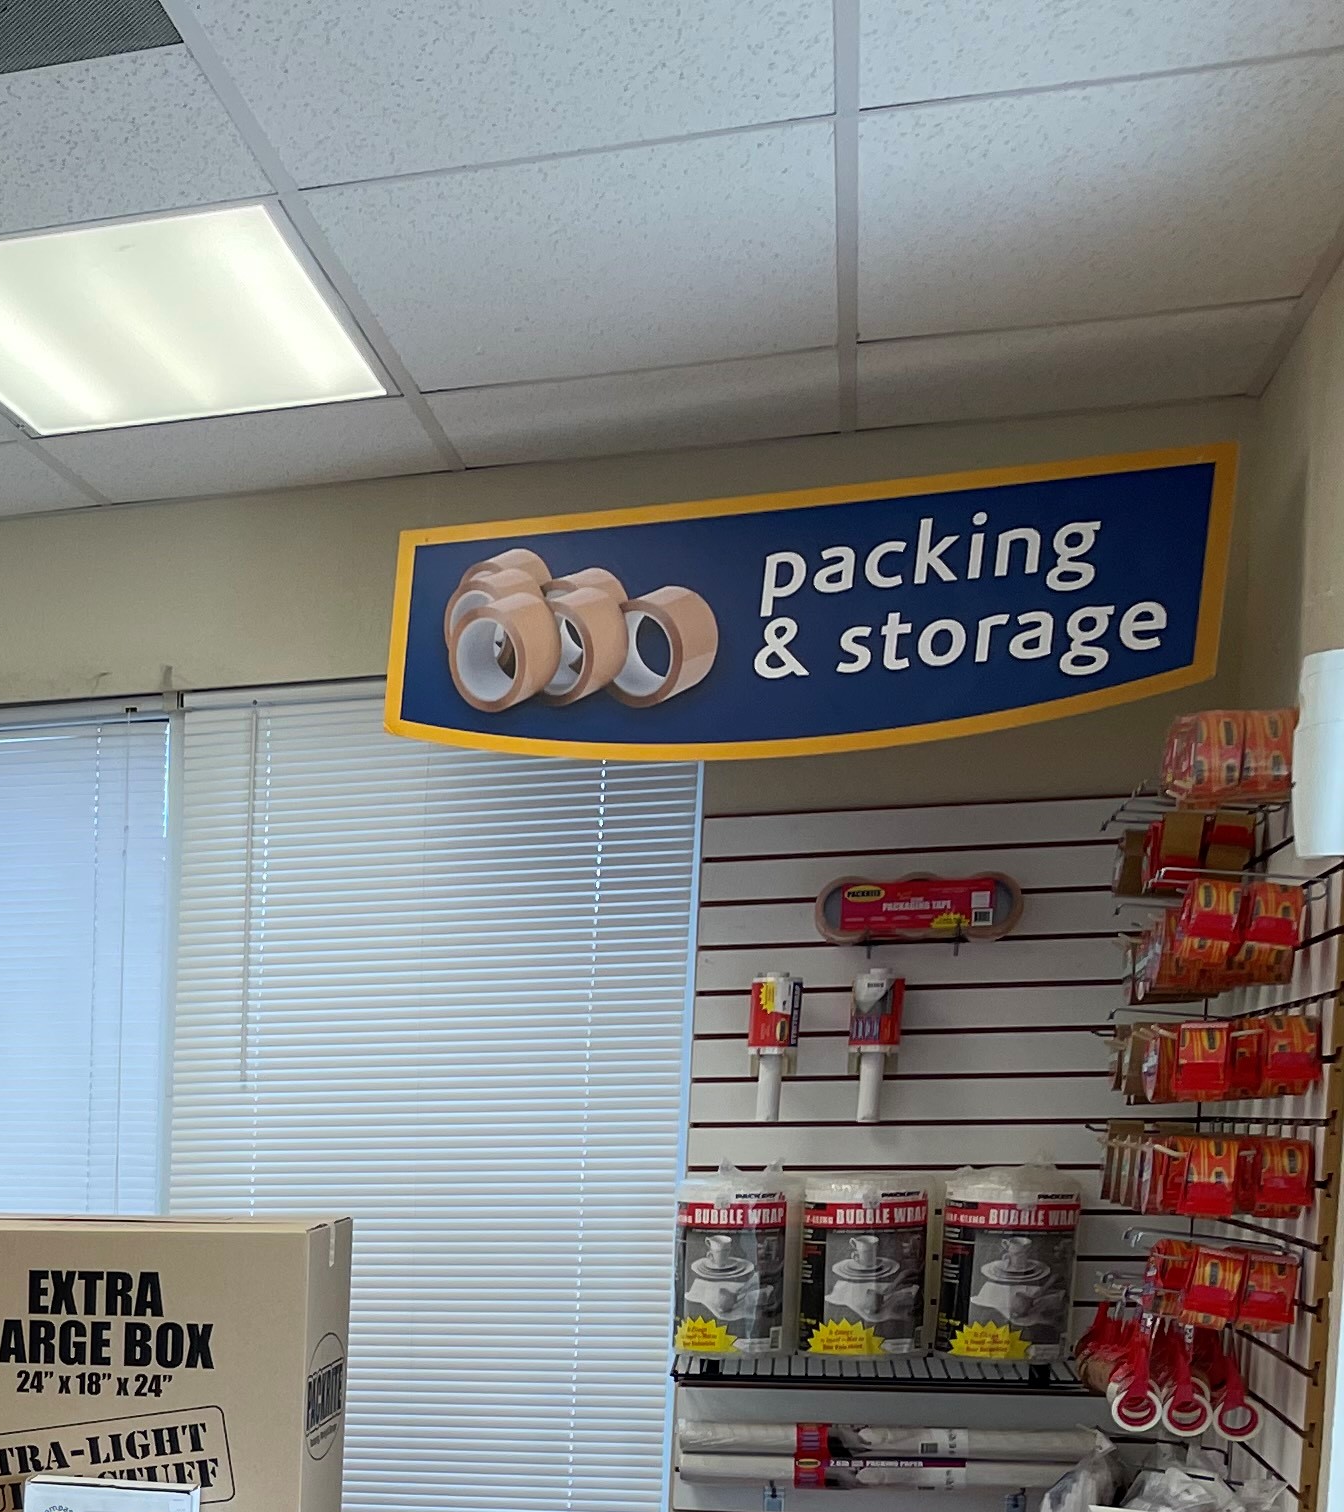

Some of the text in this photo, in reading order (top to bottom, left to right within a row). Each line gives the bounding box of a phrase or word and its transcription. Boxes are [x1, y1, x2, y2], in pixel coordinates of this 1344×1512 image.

[760, 511, 1102, 618] packing
[753, 600, 1168, 679] & storage
[694, 1208, 743, 1225] BUBBLE
[747, 1207, 784, 1224] WRAP
[836, 1208, 890, 1225] BUBBLE
[988, 1209, 1045, 1225] BUBBLE
[27, 1269, 164, 1317] EXTRA
[123, 1321, 215, 1370] BOX
[15, 1370, 174, 1398] 24" x 18" x 24"
